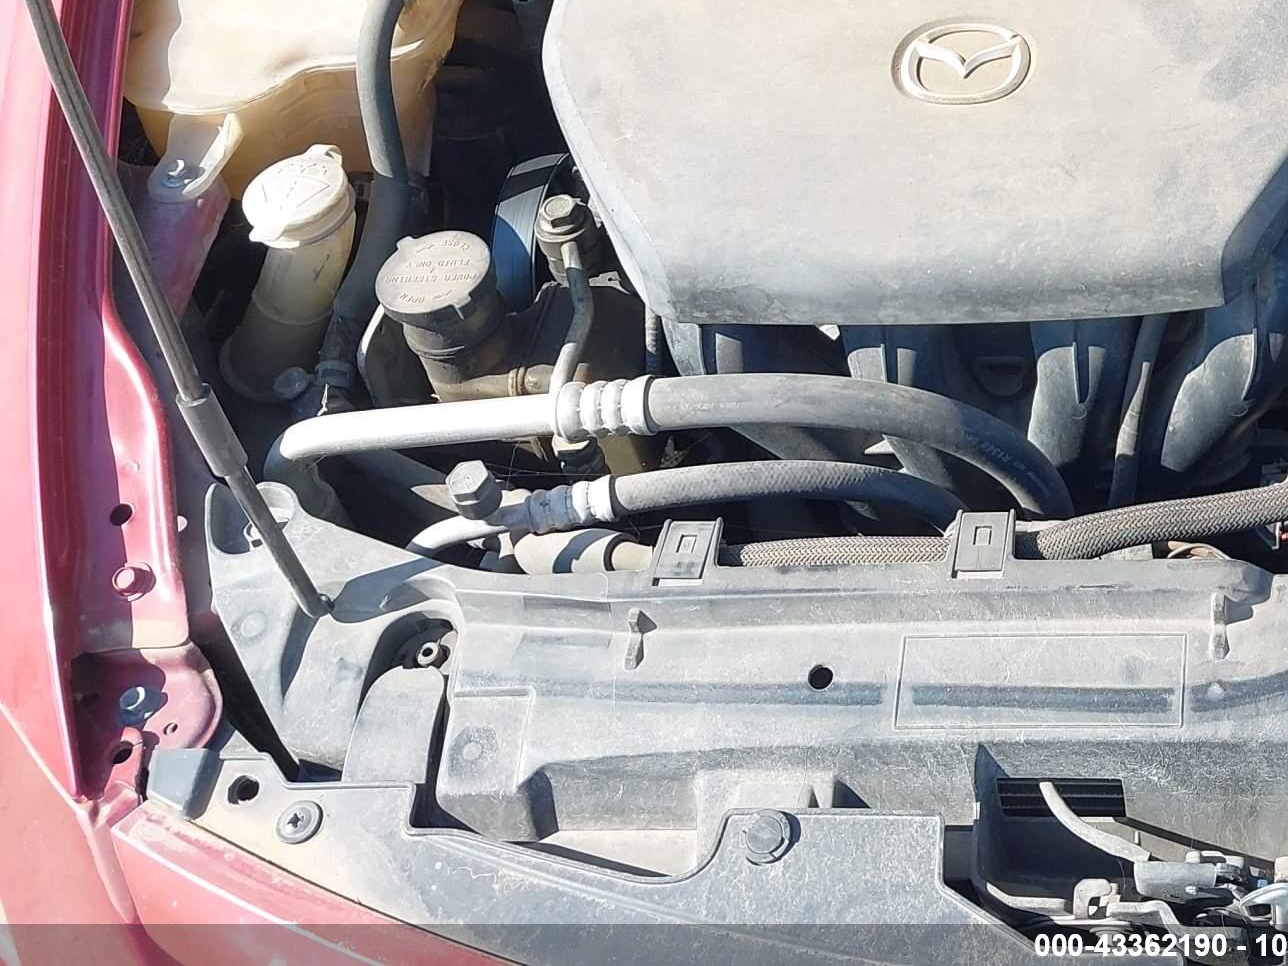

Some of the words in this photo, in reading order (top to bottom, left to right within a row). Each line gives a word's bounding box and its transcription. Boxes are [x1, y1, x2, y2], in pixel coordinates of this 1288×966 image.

[440, 239, 471, 251] CLOSE
[437, 259, 470, 267] FLUID
[385, 274, 438, 283] STEERING
[444, 273, 477, 282] POWER
[400, 292, 425, 303] OPEN
